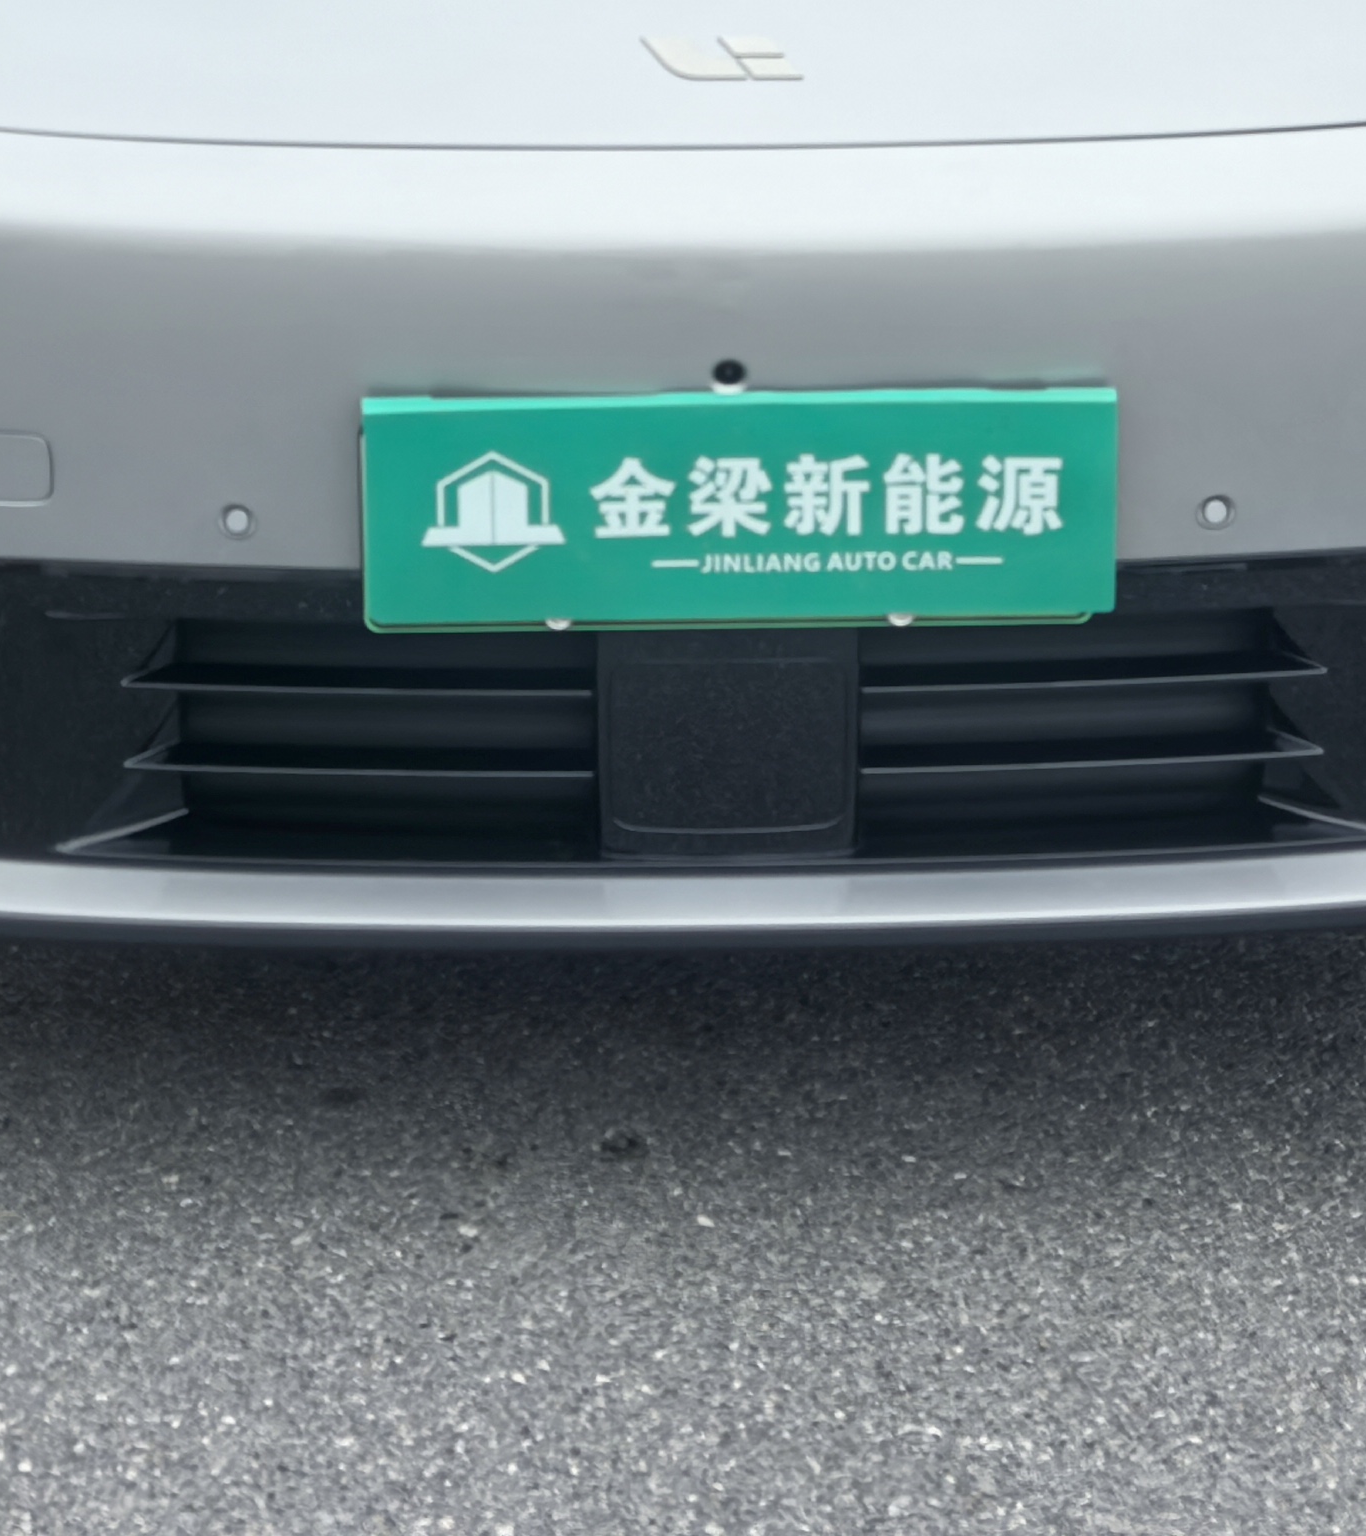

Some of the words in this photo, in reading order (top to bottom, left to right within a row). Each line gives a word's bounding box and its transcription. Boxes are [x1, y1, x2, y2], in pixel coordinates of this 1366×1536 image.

[589, 453, 1065, 539] 金梁新能源
[701, 552, 822, 574] JINLIANG
[827, 551, 897, 572] AUTO
[902, 550, 954, 572] CAR
